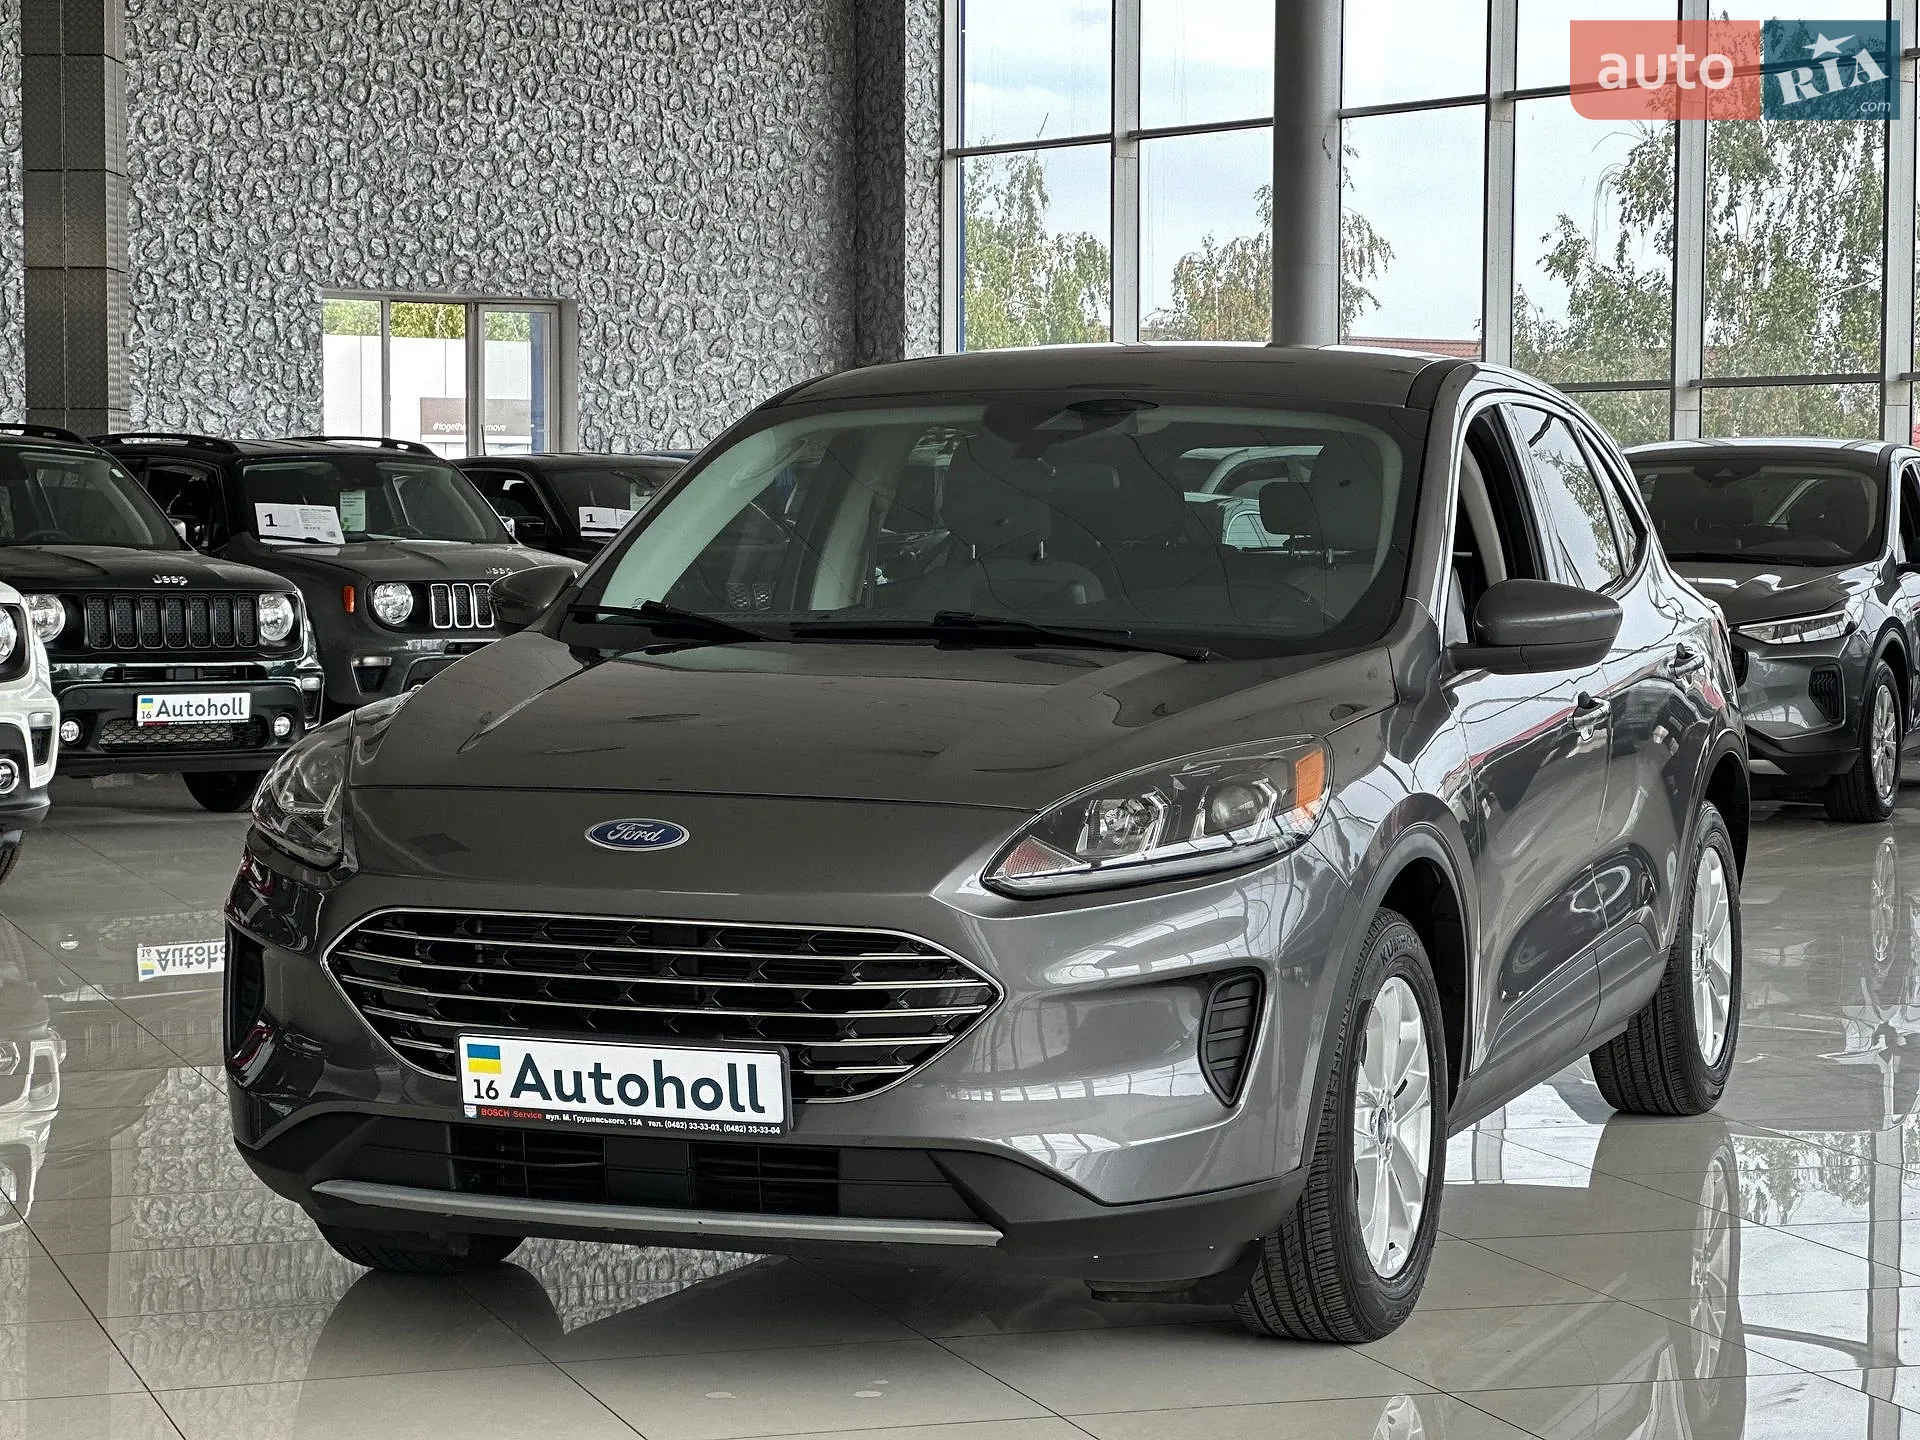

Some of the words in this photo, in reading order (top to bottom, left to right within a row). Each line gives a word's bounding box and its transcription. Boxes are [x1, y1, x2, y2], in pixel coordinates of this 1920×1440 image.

[264, 513, 278, 527] 1
[585, 513, 597, 523] 1
[152, 574, 188, 586] Jeep
[141, 711, 152, 719] 16
[155, 697, 244, 718] Autoholl
[606, 822, 666, 842] Ford
[473, 1079, 499, 1100] 16
[510, 1053, 766, 1114] Autoholl
[481, 1108, 510, 1118] BOSCH
[513, 1110, 543, 1120] Service
[545, 1114, 562, 1123] вул.
[563, 1114, 572, 1122] М.
[573, 1114, 628, 1127] Грушевського,
[647, 1120, 664, 1128] тел.
[664, 1120, 688, 1130] (0482)
[688, 1122, 722, 1132] 33-33-03,
[723, 1123, 747, 1133] (0482)
[748, 1125, 780, 1135] 33-33-04
